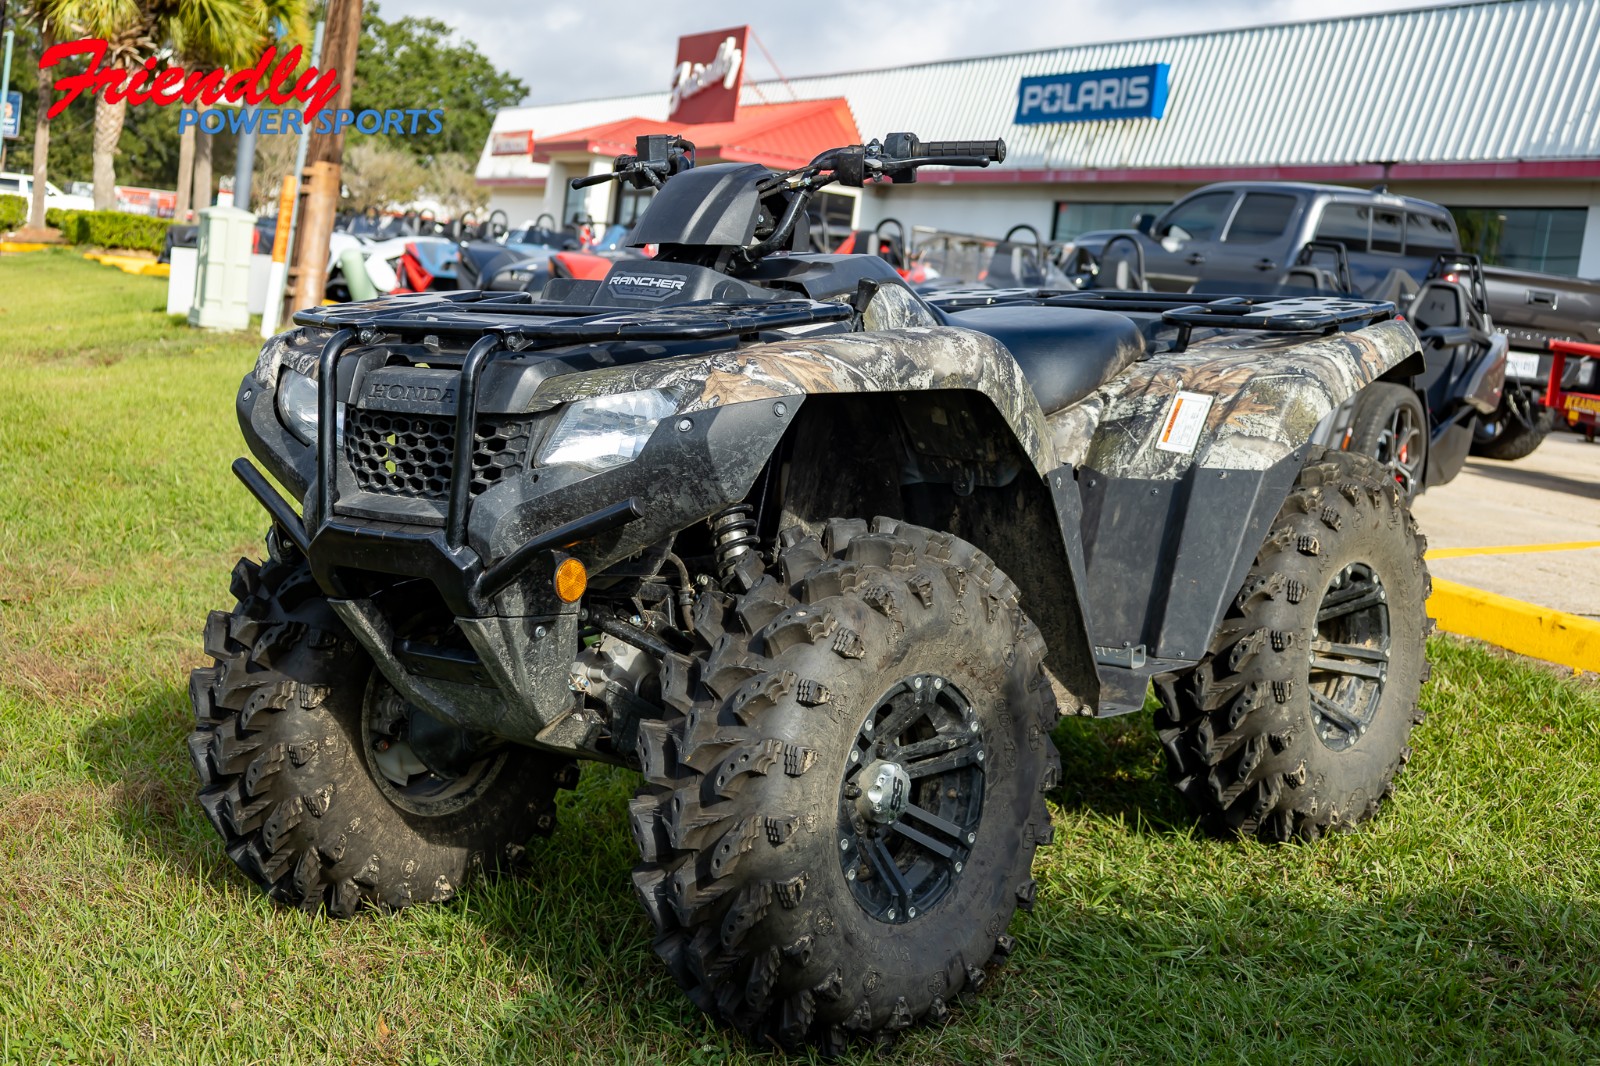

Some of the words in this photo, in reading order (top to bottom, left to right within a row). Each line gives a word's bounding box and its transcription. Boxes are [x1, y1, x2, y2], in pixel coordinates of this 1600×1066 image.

[1021, 75, 1150, 116] POLARIS
[608, 276, 686, 290] RANCHER
[367, 383, 456, 404] HONDA
